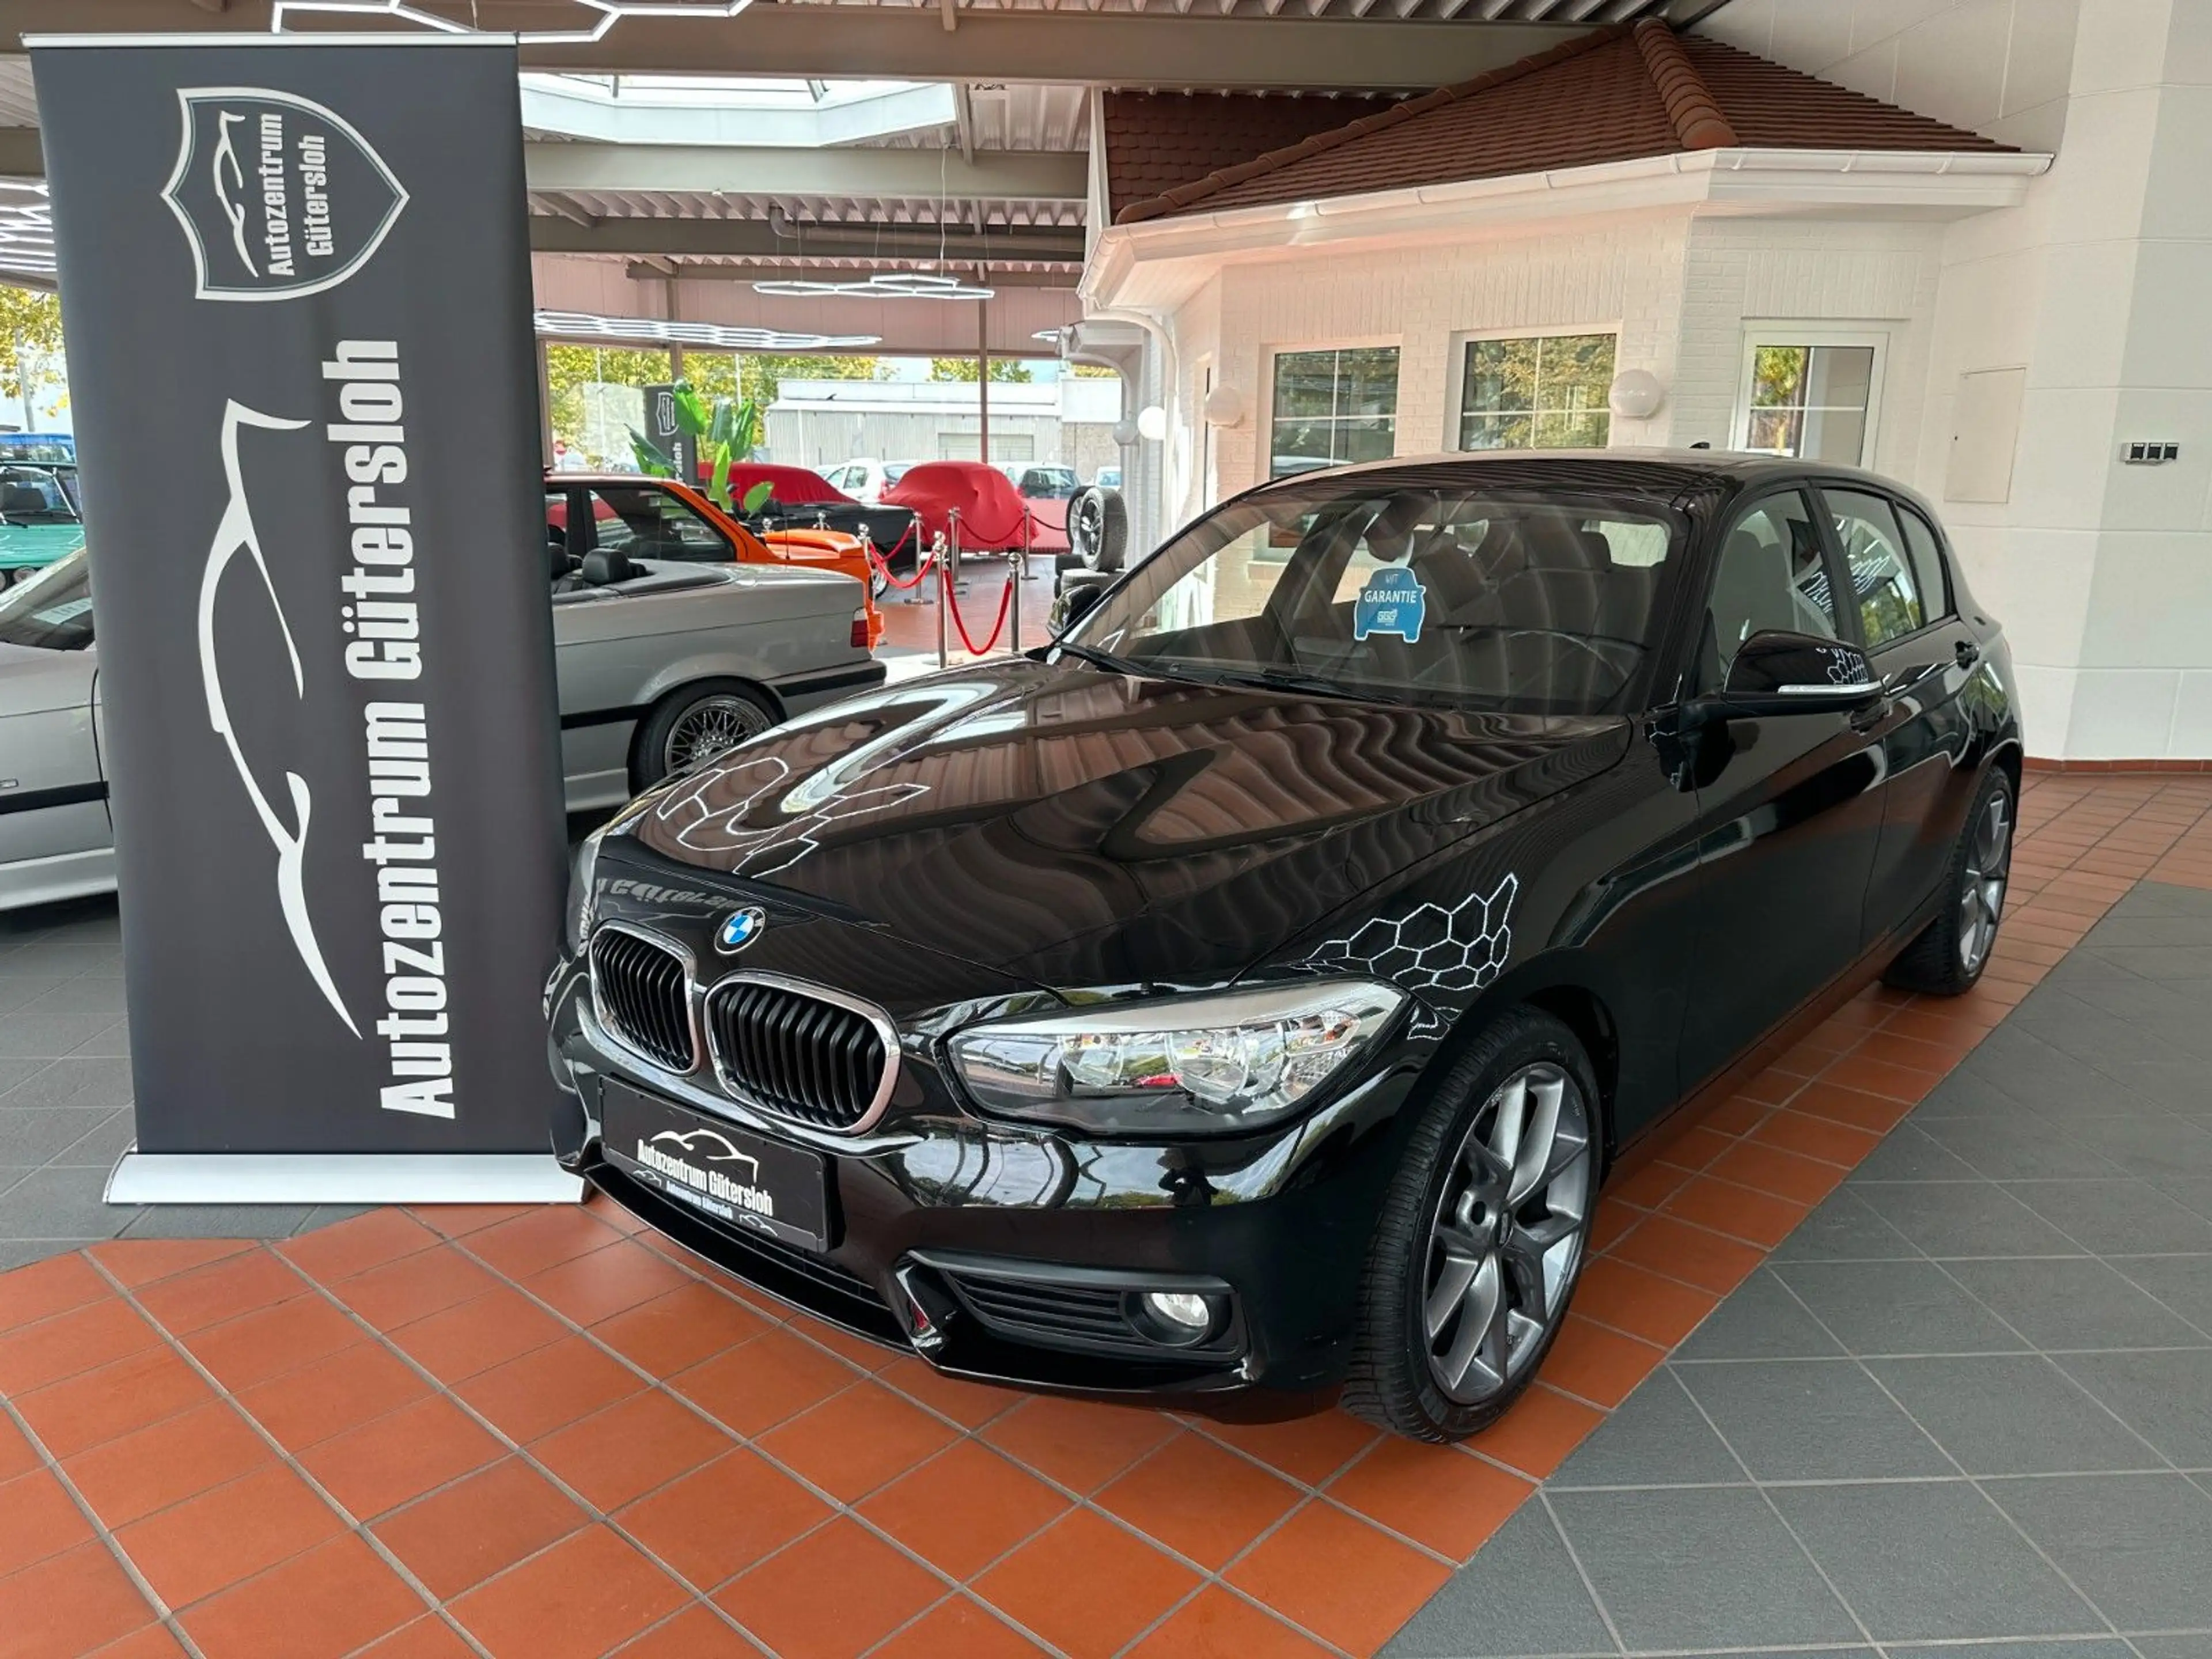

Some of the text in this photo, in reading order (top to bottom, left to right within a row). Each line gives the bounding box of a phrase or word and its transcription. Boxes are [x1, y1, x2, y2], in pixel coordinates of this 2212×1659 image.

[259, 113, 295, 276] Autozentrum
[298, 135, 334, 256] Gütersloh
[1364, 590, 1418, 604] GARANTIE
[322, 340, 456, 1119] Autozentrum Gütersloh
[638, 1139, 707, 1192] Autozentrum
[709, 1170, 774, 1217] Gütersloh
